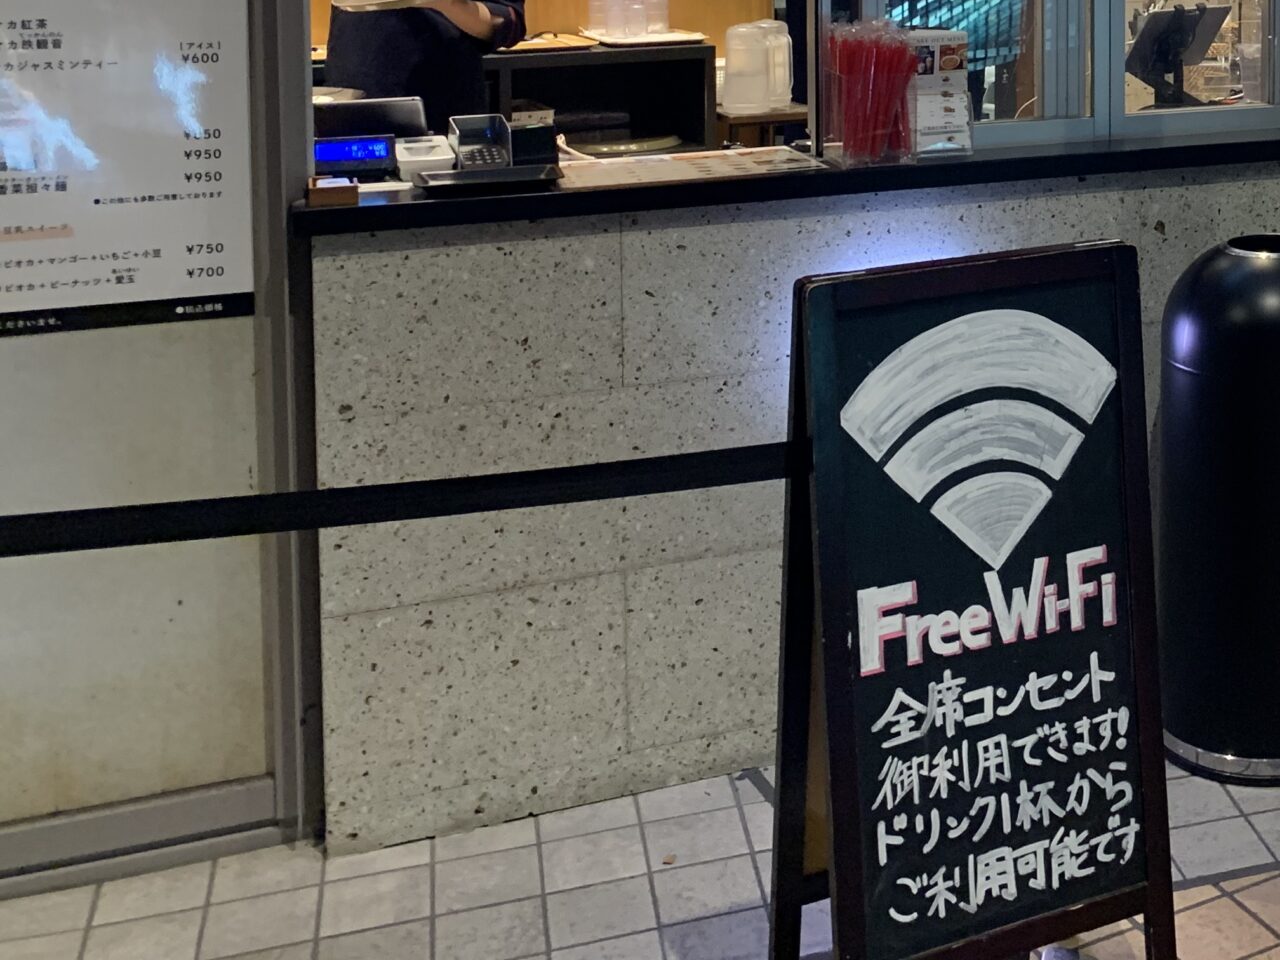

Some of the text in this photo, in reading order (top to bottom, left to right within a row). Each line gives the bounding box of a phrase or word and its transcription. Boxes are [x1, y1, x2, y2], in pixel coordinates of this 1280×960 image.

[0, 19, 48, 31] カ紅茶
[0, 38, 63, 50] カ鉄観音
[182, 52, 220, 64] ¥600
[183, 128, 222, 140] ¥50
[183, 148, 222, 161] ¥950
[184, 171, 223, 184] ¥950
[185, 243, 224, 255] ¥750
[186, 266, 225, 278] ¥700
[0, 316, 62, 330] ださいませ。
[856, 543, 1117, 677] Free Wi-Fi
[870, 650, 1116, 749] 全席コンセント
[887, 813, 1140, 923] ご利用可能です
